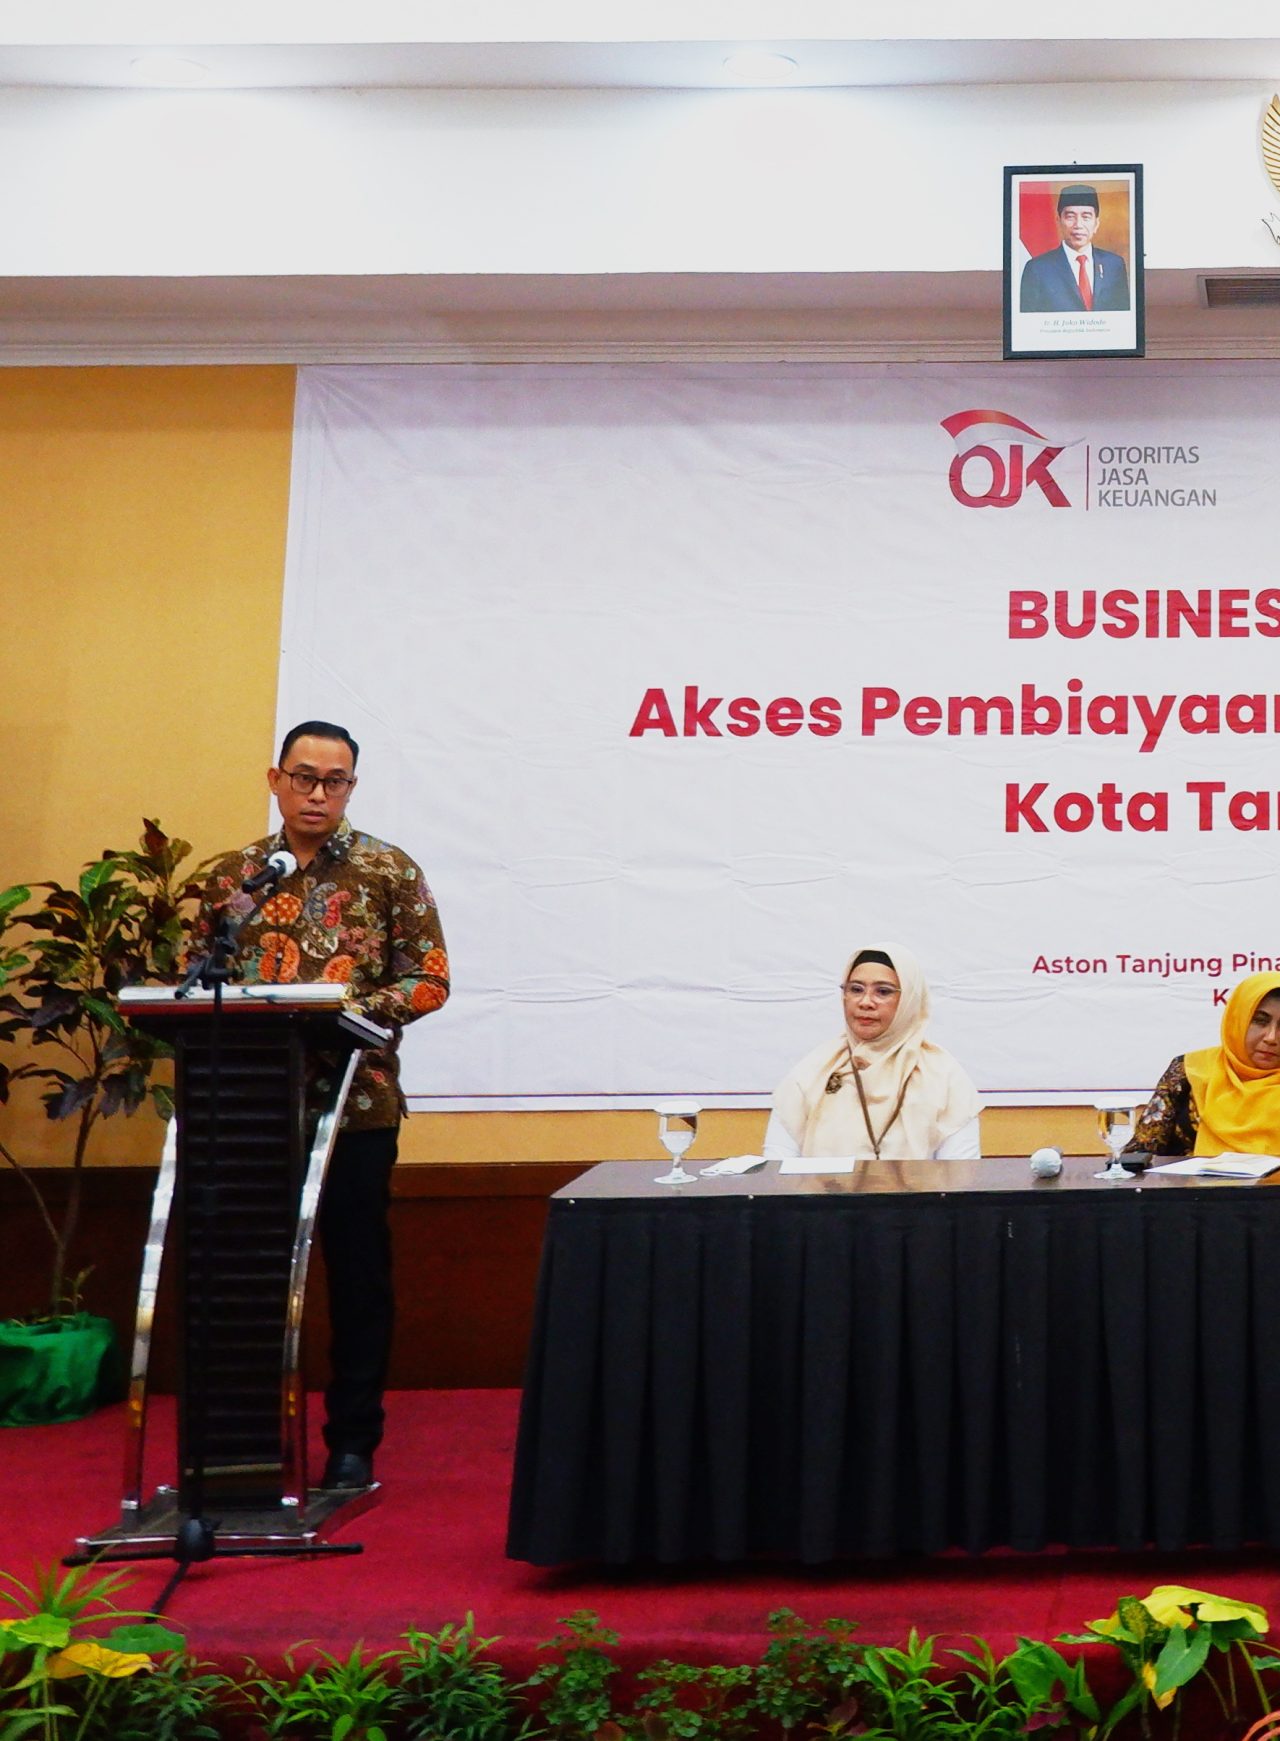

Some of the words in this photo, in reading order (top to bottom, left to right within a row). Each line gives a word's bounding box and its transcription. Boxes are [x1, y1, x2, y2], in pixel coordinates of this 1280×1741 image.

[1097, 445, 1200, 465] OTORITAS
[948, 443, 1073, 509] OJK
[1097, 467, 1149, 486] JASA
[1098, 488, 1217, 508] KEUANGAN
[629, 685, 842, 738] Akses
[1005, 782, 1169, 833] Kota
[1032, 955, 1108, 975] Aston
[1117, 953, 1223, 977] Tanjung
